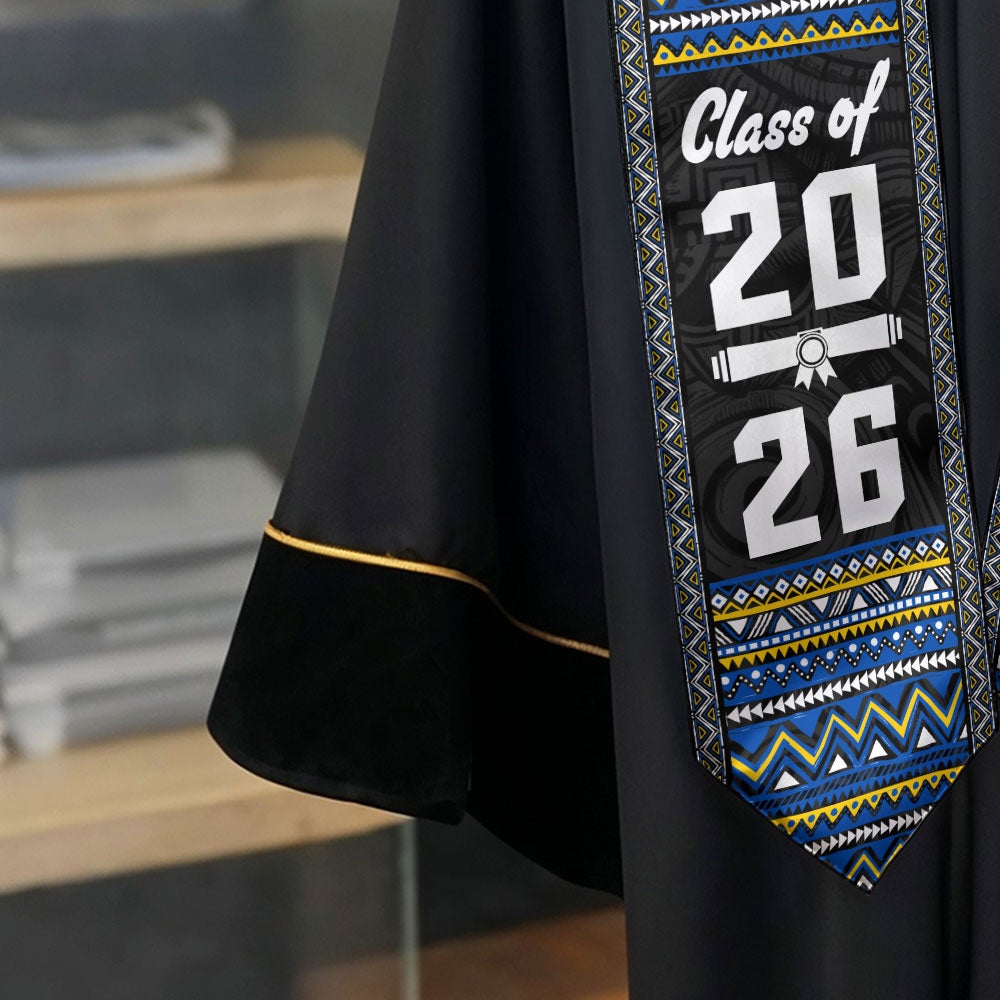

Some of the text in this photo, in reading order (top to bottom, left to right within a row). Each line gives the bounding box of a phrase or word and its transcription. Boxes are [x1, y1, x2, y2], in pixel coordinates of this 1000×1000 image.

[681, 56, 891, 164] Class of
[700, 162, 888, 332] 20
[732, 384, 906, 560] 26
